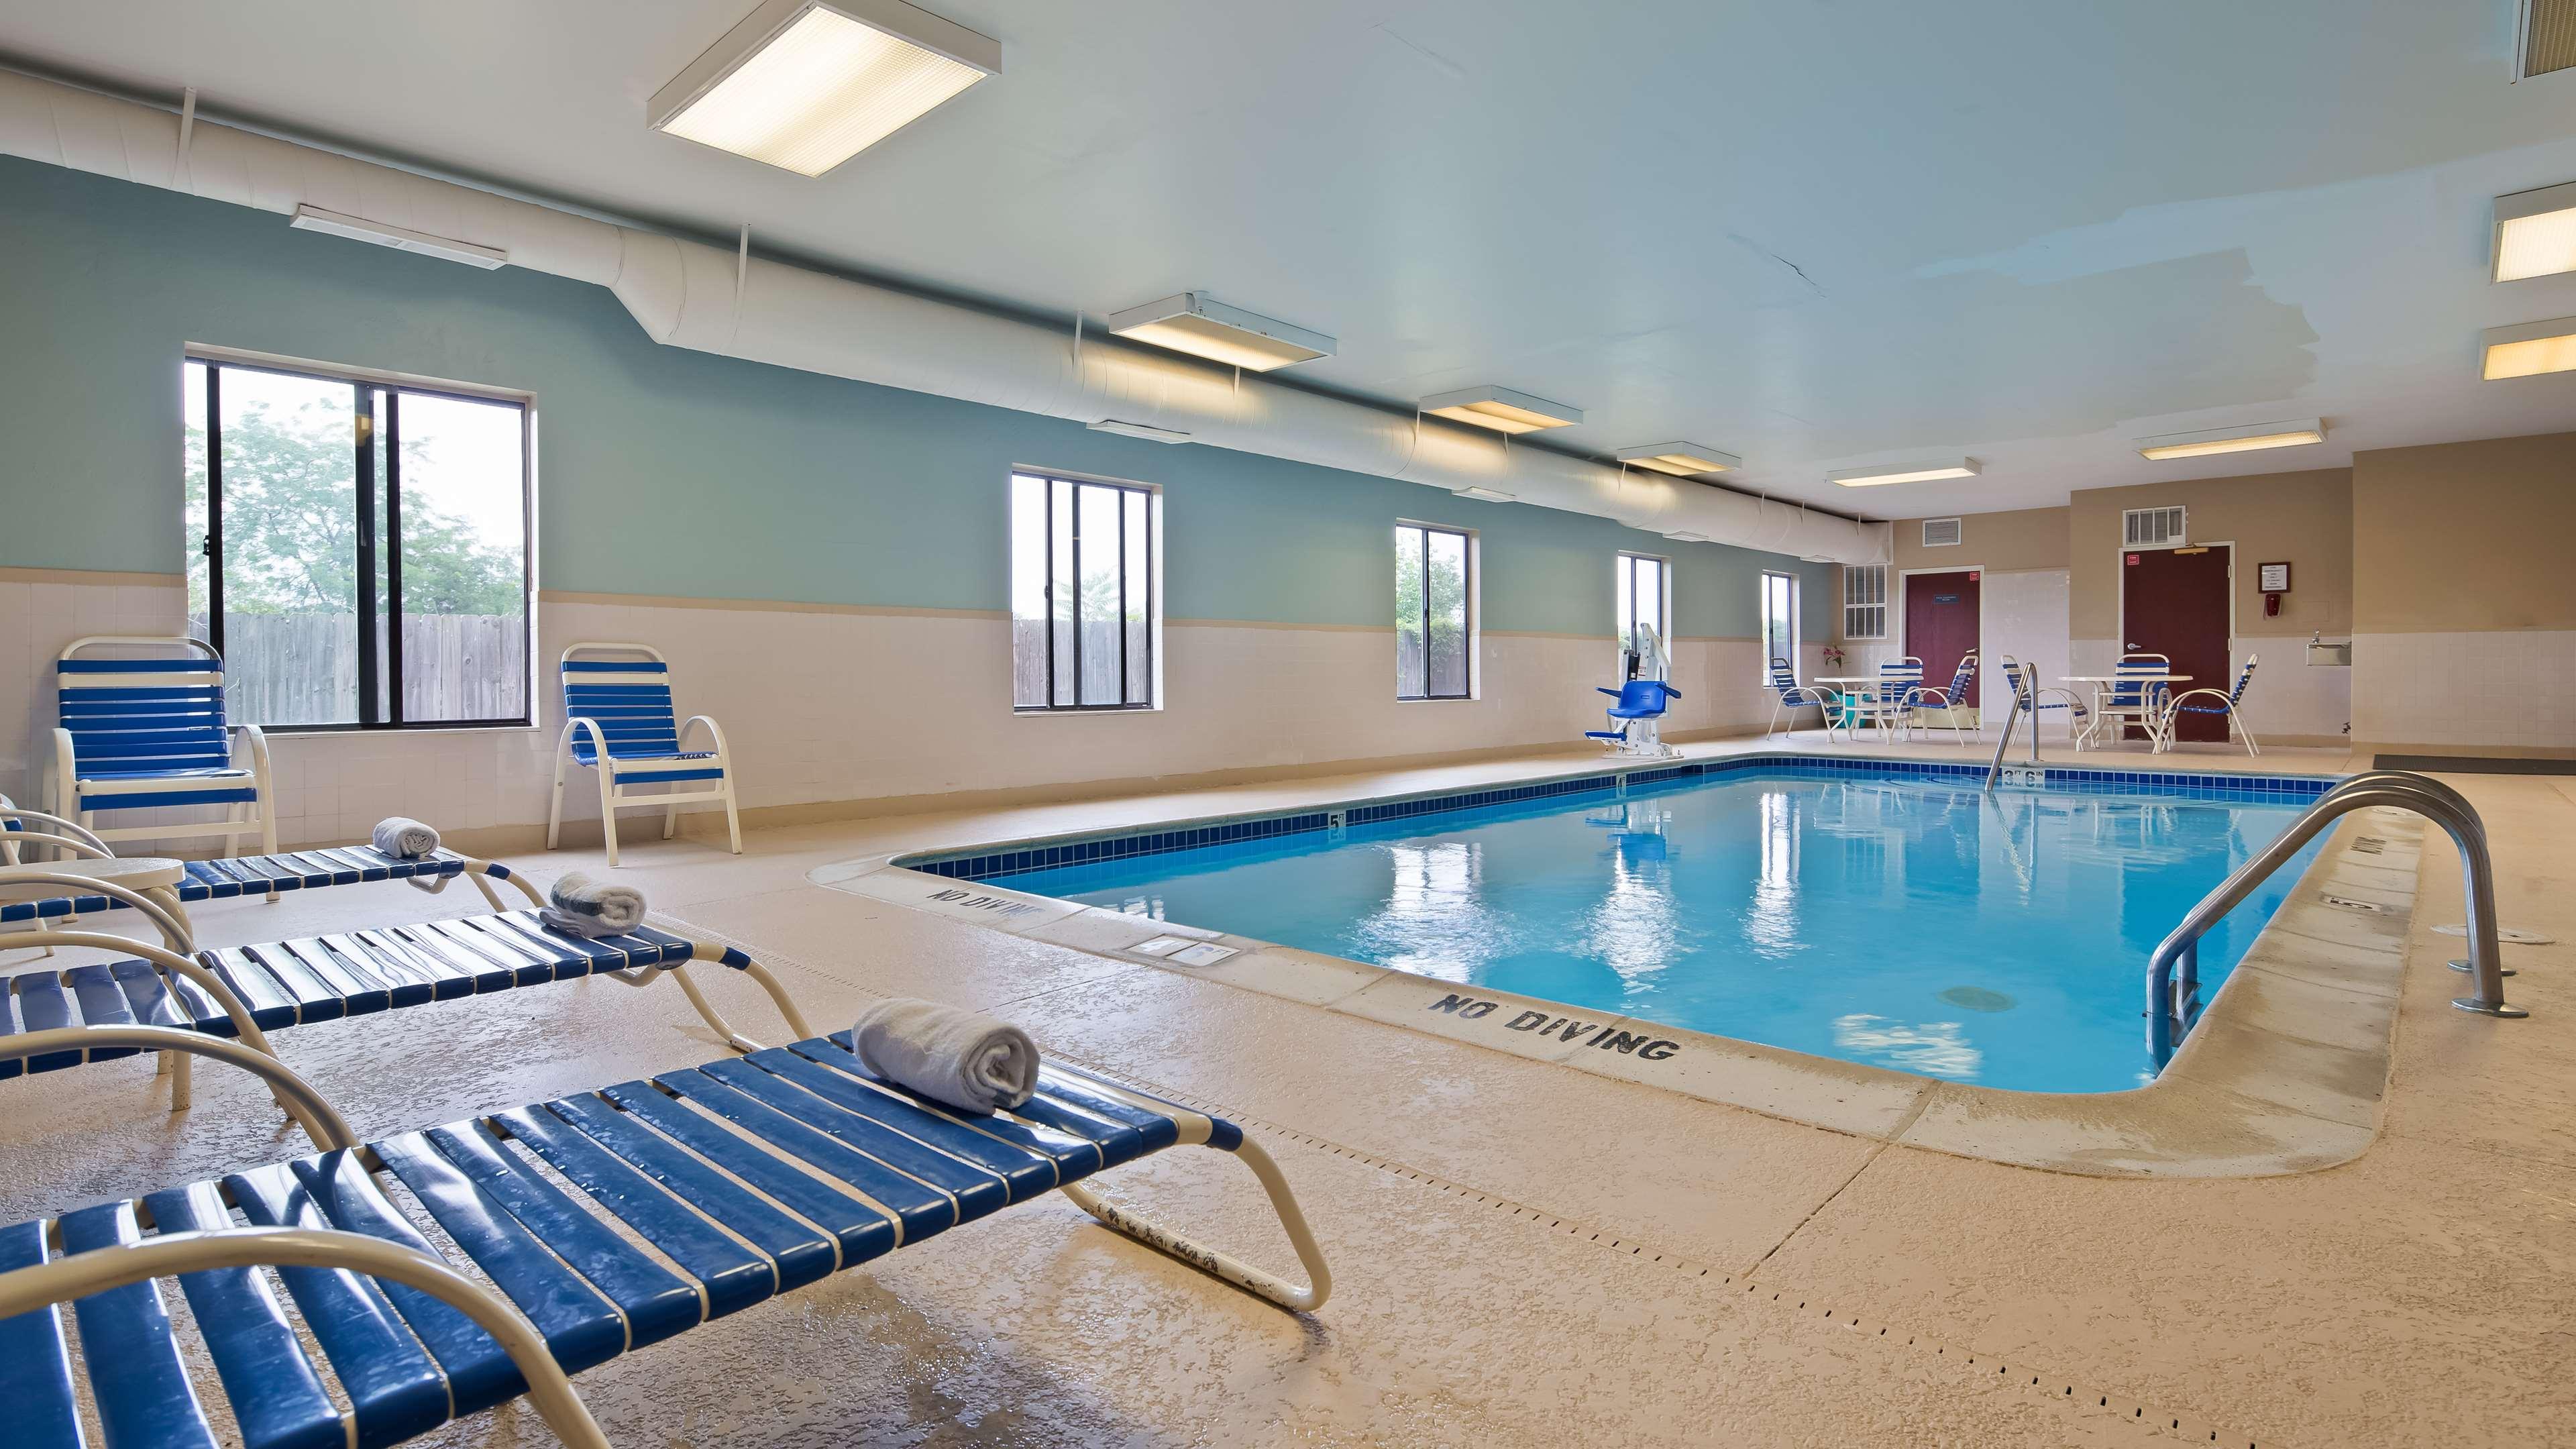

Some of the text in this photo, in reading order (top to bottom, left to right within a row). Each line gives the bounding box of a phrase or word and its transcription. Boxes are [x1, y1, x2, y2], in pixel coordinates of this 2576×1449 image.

[1330, 814, 1339, 828] 5
[926, 889, 970, 902] NO
[1428, 994, 1680, 1061] NO DIVING
